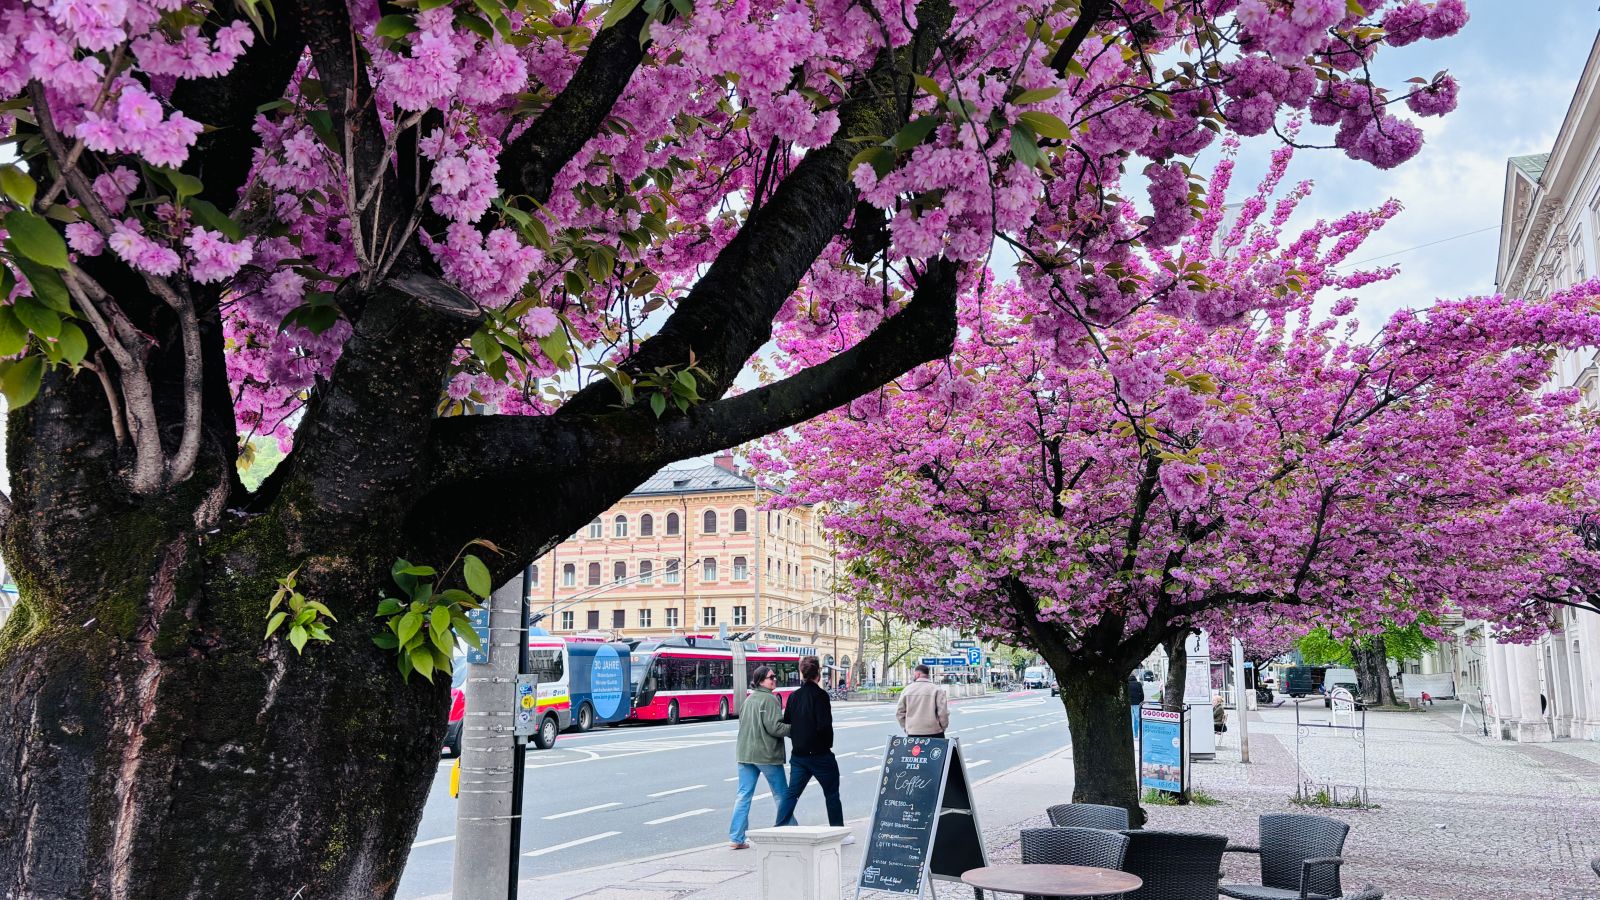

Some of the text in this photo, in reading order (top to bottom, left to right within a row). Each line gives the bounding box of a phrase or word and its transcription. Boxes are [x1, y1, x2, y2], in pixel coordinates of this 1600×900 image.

[971, 652, 978, 661] P
[594, 660, 620, 669] 30 JAHRE
[900, 756, 928, 764] TRUMER
[894, 770, 932, 796] Coffee
[884, 799, 907, 807] ESPRESSO
